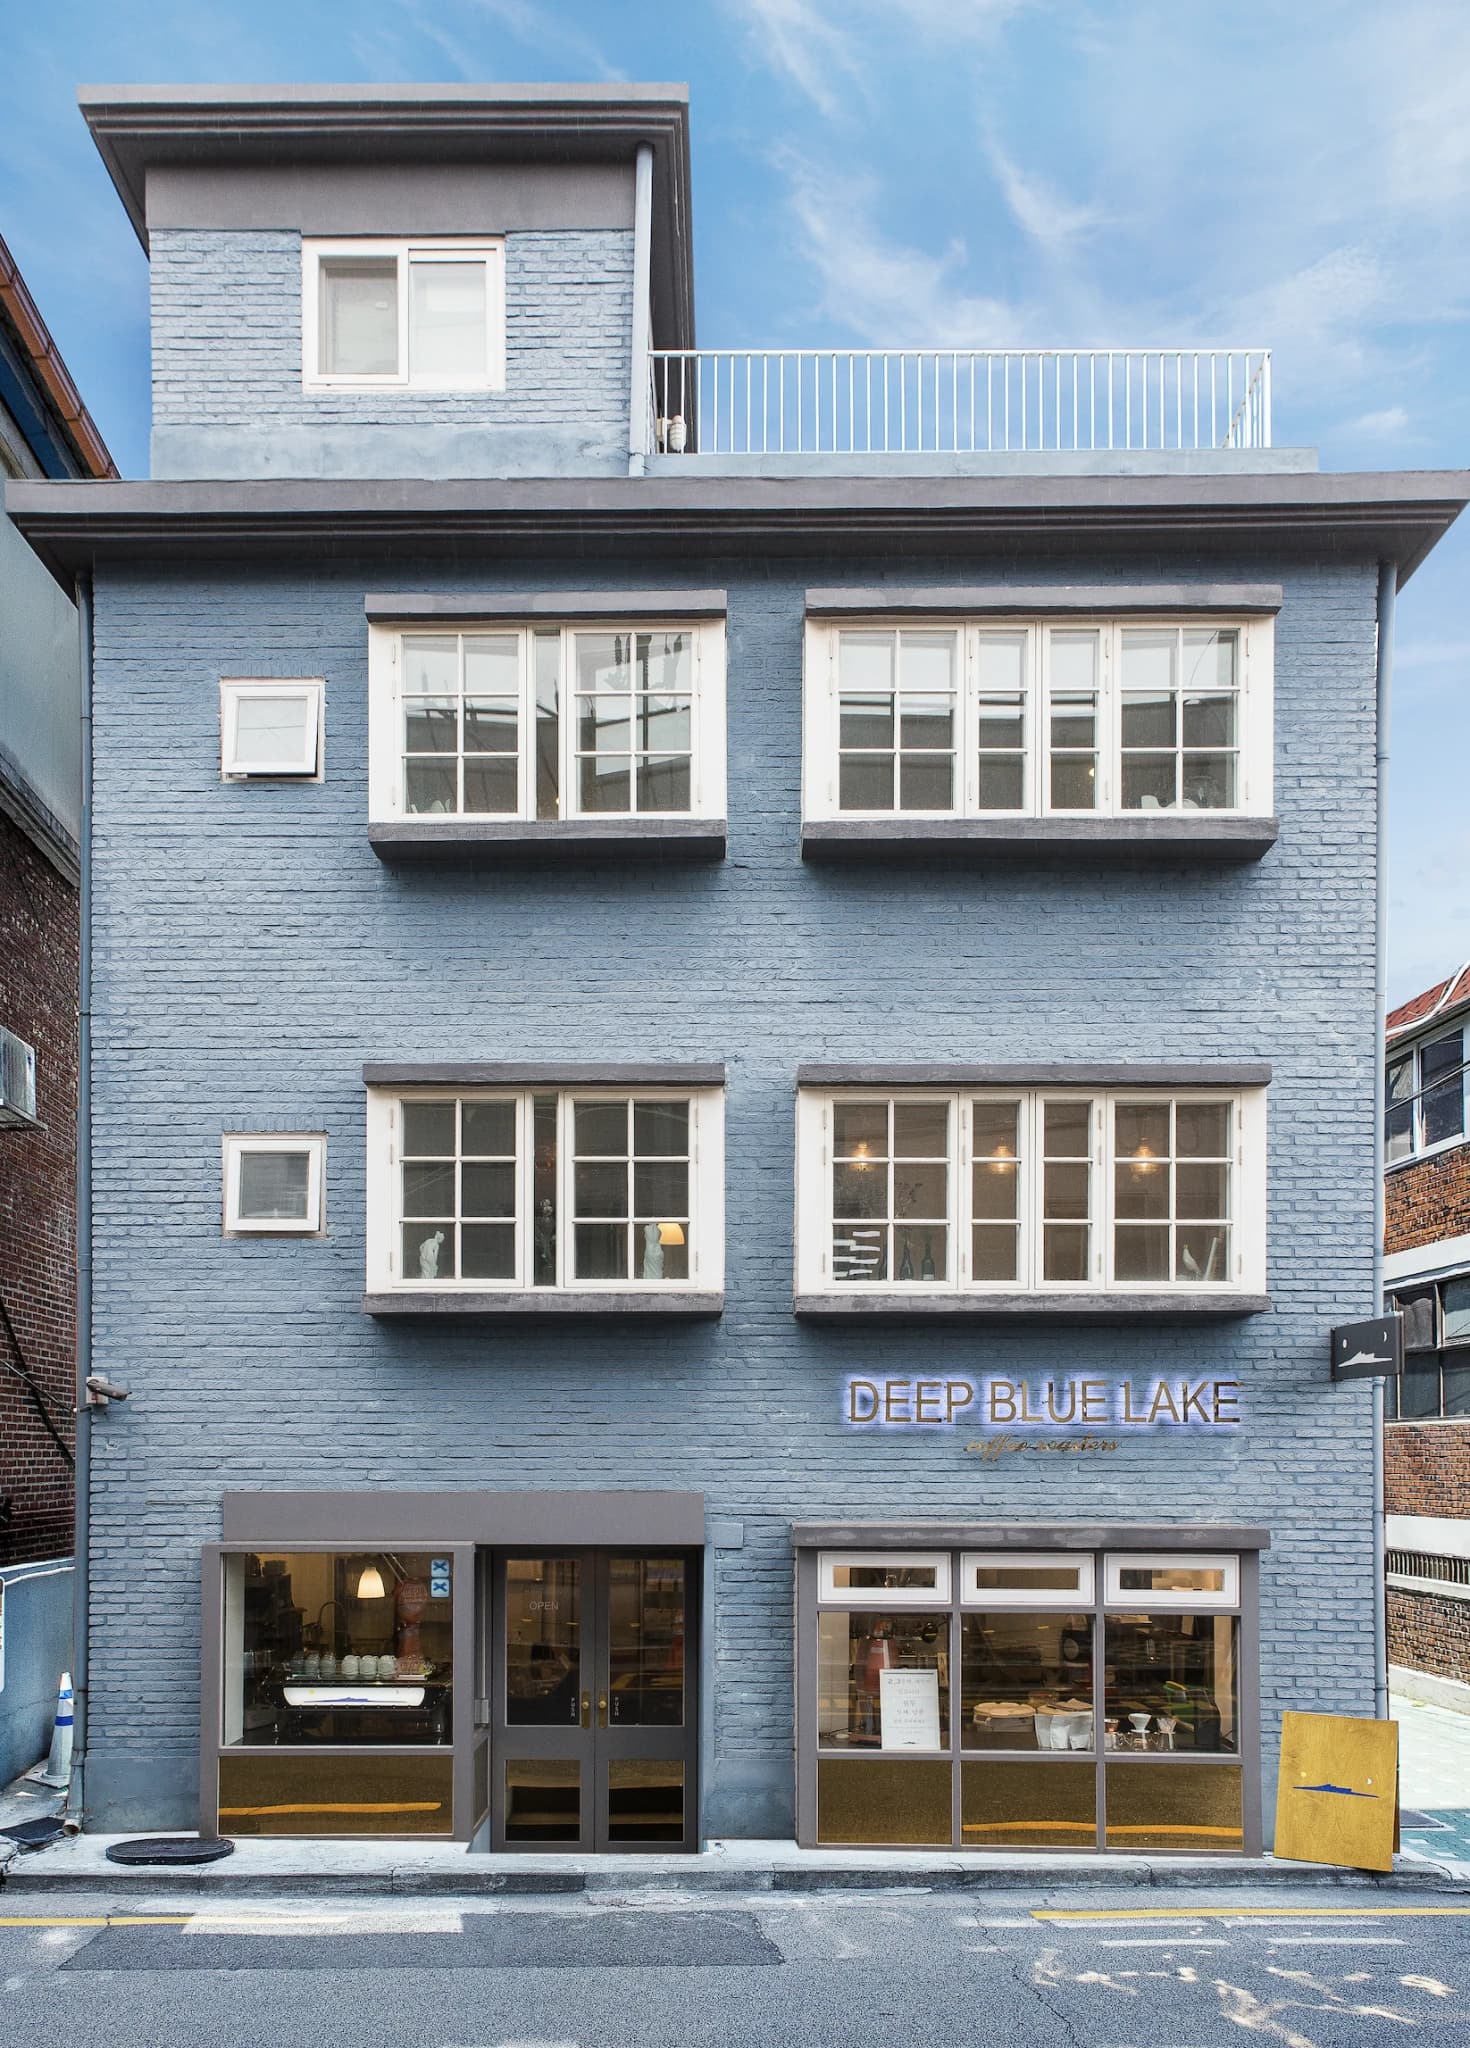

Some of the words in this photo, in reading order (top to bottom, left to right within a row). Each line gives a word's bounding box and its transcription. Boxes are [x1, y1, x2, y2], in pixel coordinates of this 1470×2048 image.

[849, 1381, 974, 1423] DEEP
[990, 1380, 1108, 1423] BLUE
[1123, 1381, 1241, 1423] LAKE
[963, 1433, 1028, 1462] coffee
[1037, 1432, 1119, 1451] roasters
[529, 1601, 559, 1610] OPEN
